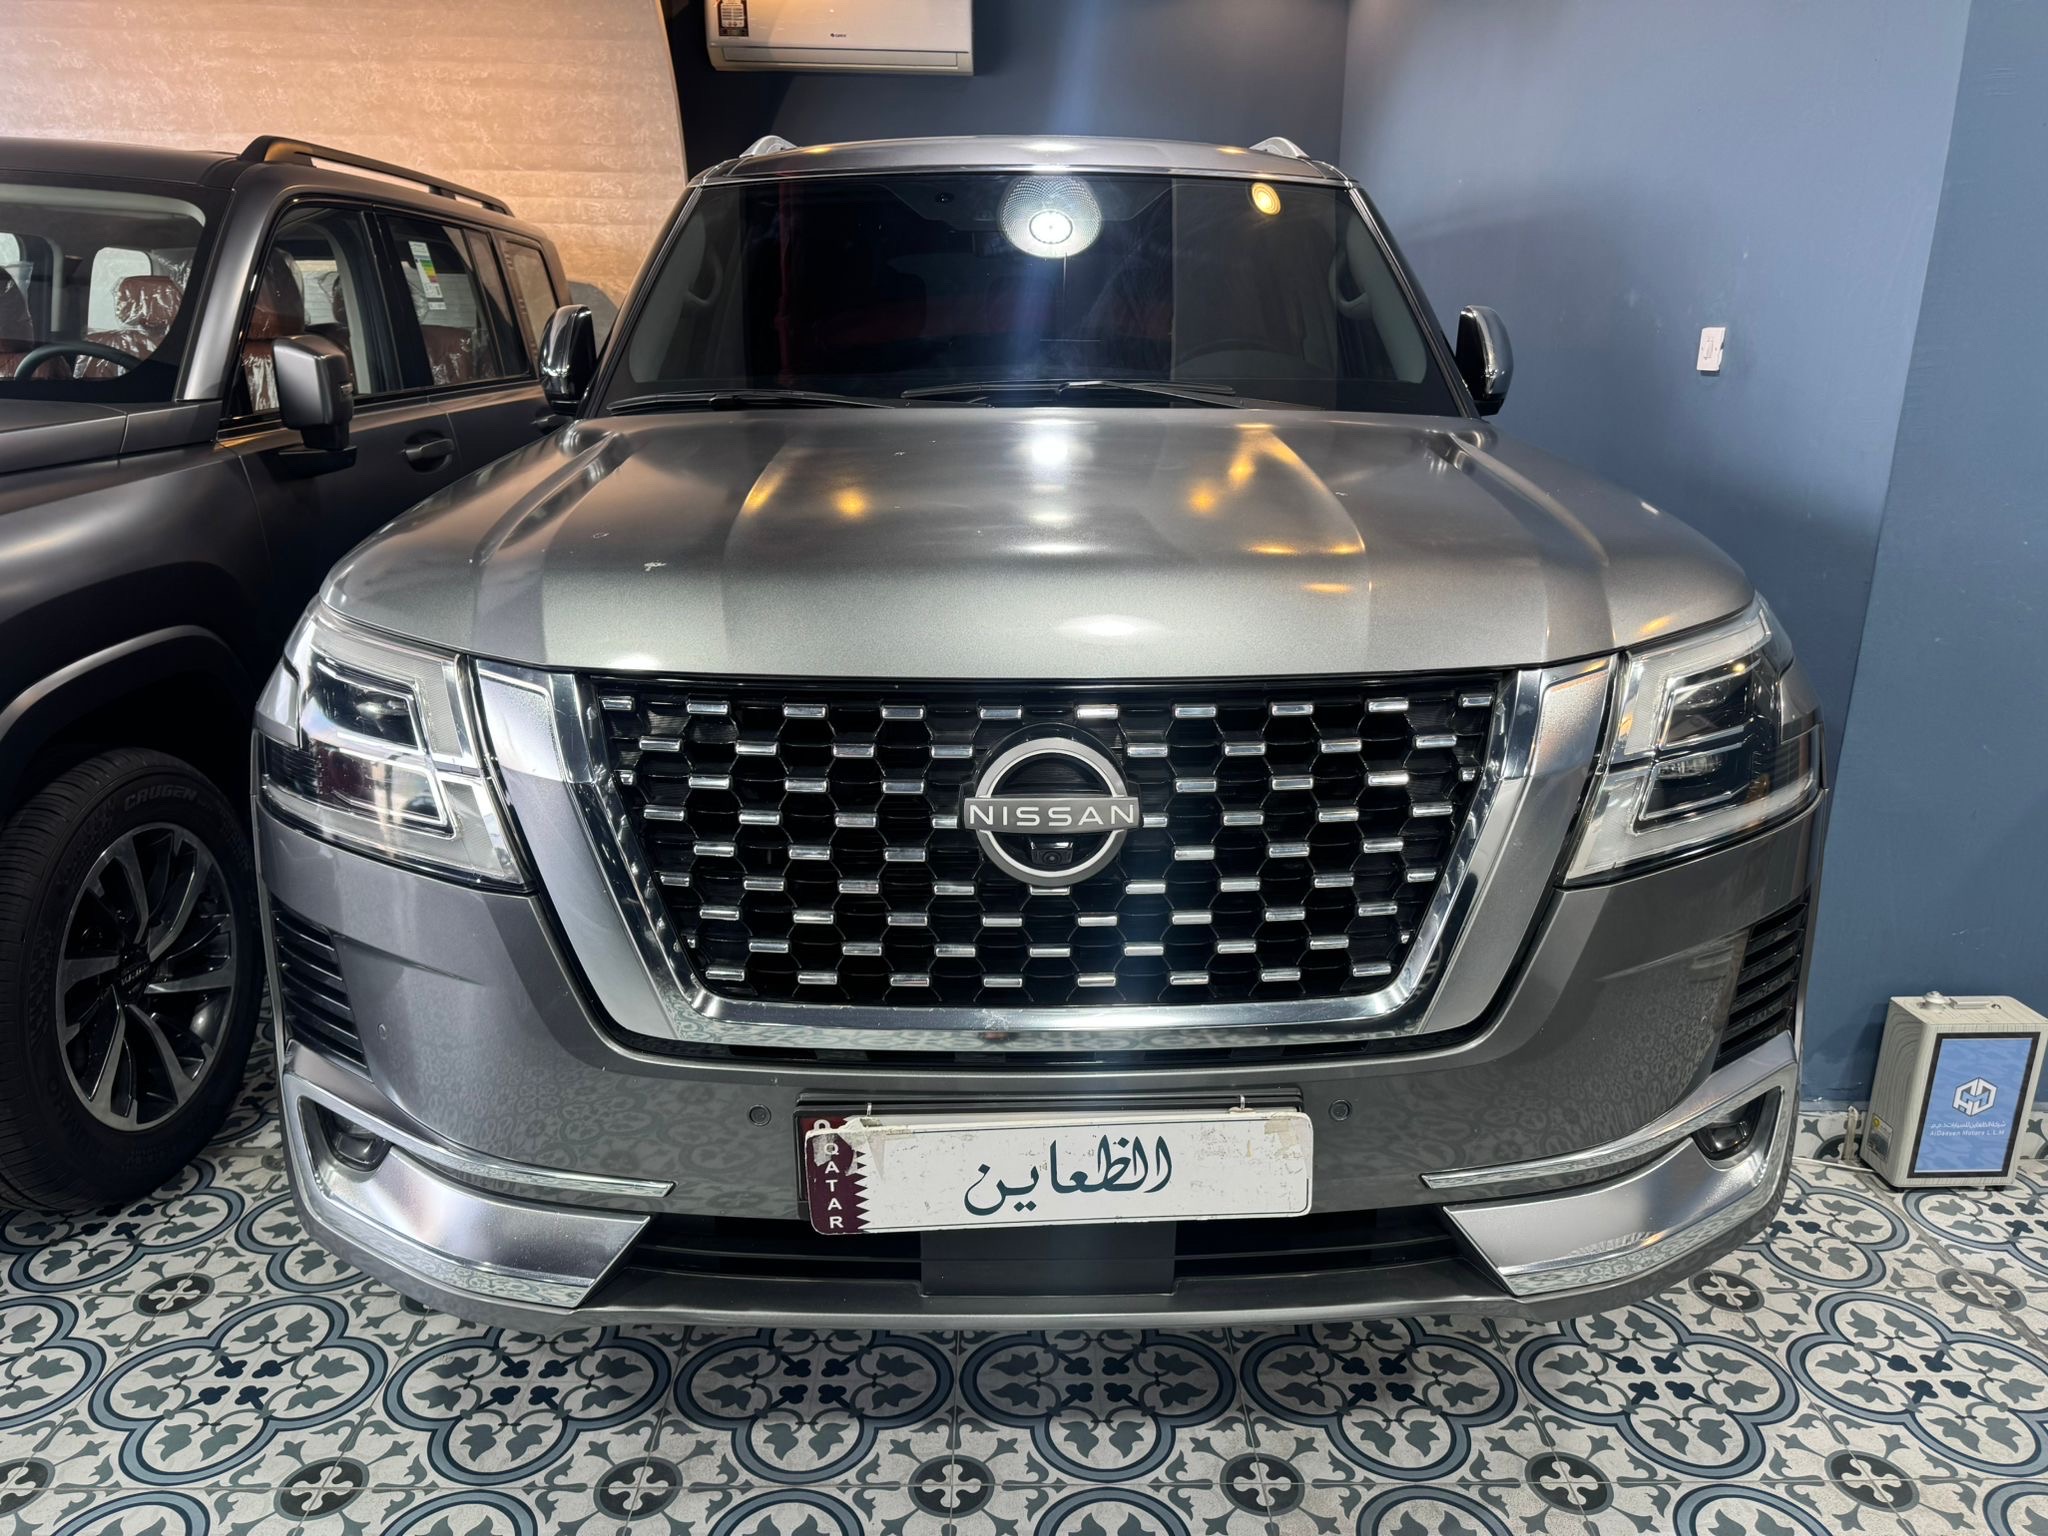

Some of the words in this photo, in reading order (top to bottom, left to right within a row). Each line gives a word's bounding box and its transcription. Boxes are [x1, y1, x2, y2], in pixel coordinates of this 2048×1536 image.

[969, 804, 1134, 827] NISSAN
[824, 1142, 844, 1229] QATAR
[963, 1134, 1173, 1216] الظعاين
